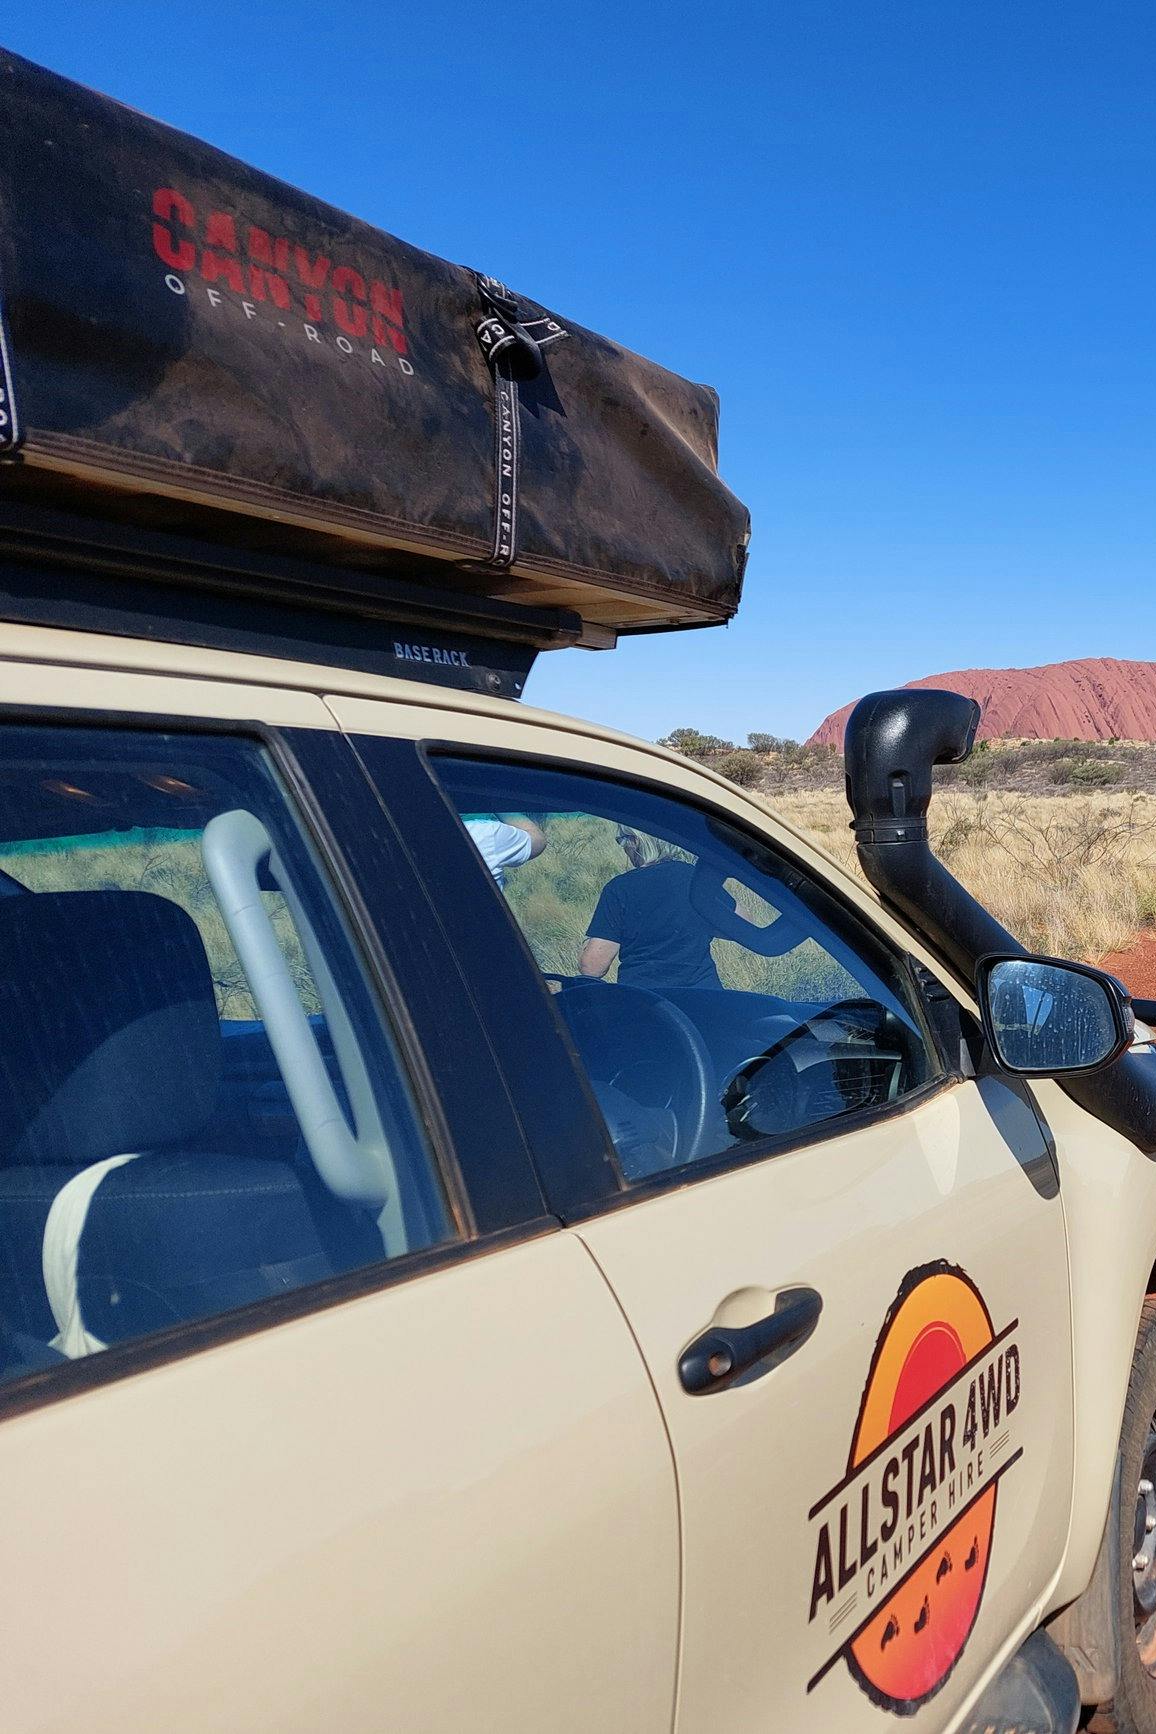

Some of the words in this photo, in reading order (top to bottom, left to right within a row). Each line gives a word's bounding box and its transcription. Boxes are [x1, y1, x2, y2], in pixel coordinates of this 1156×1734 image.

[152, 187, 408, 355] CANYON
[164, 273, 415, 377] OFF-ROAD
[501, 390, 512, 477] CANYON
[808, 1403, 957, 1624] ALLSTAR
[962, 1343, 1021, 1454] 4WD
[866, 1500, 939, 1599] CAMPER
[947, 1450, 985, 1510] HIRE
